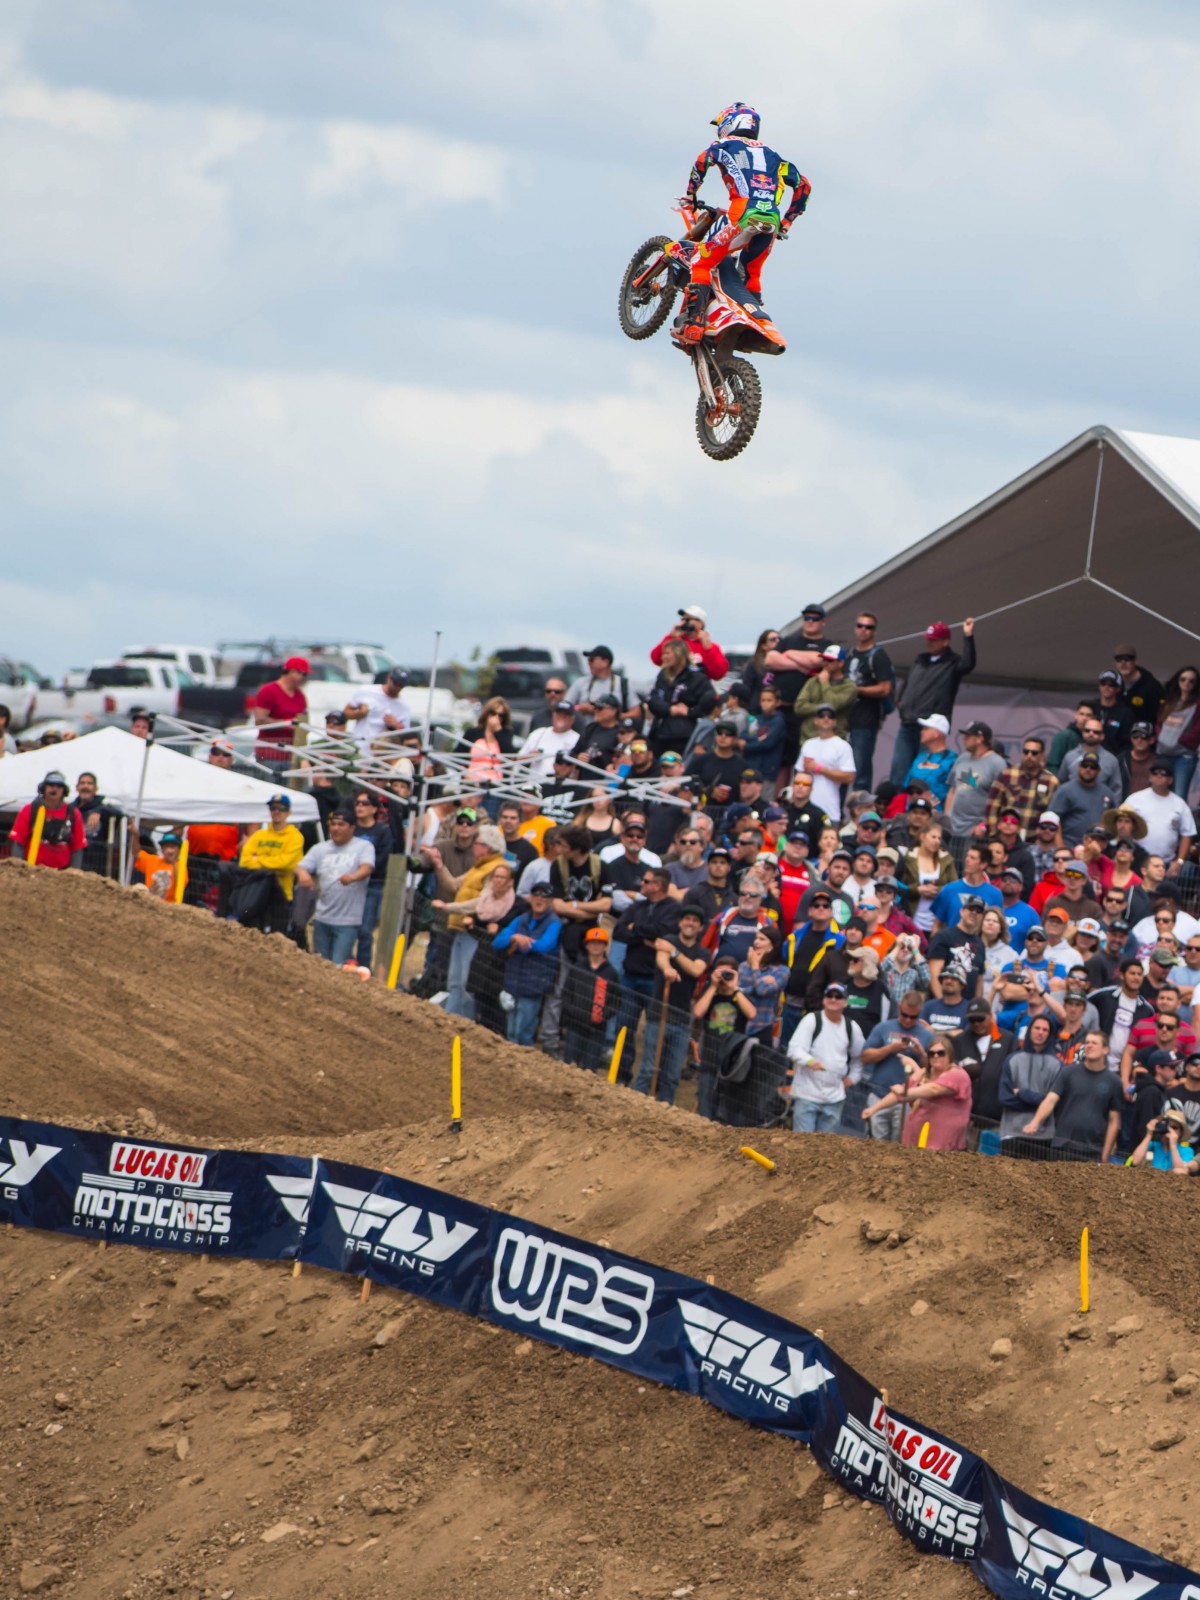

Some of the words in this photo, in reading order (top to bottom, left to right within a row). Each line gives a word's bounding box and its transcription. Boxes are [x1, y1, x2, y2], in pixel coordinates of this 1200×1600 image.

[746, 146, 767, 172] 1
[113, 1146, 178, 1181] LUCAS
[179, 1154, 201, 1183] OIL
[136, 1181, 182, 1198] PRO
[72, 1215, 230, 1246] CHAMPIONSHIP
[74, 1185, 232, 1234] MOTOCROSS
[320, 1181, 479, 1262] FLY
[344, 1237, 436, 1276] RACING
[492, 1227, 655, 1356] WPS
[677, 1298, 836, 1399] FLY
[700, 1360, 791, 1413] RACING
[873, 1404, 923, 1461] LCAS
[919, 1444, 957, 1482] OIL
[830, 1454, 976, 1559] CHAMPIONSHIP
[834, 1424, 981, 1547] MOTOCROSS
[1001, 1498, 1160, 1600] FLY
